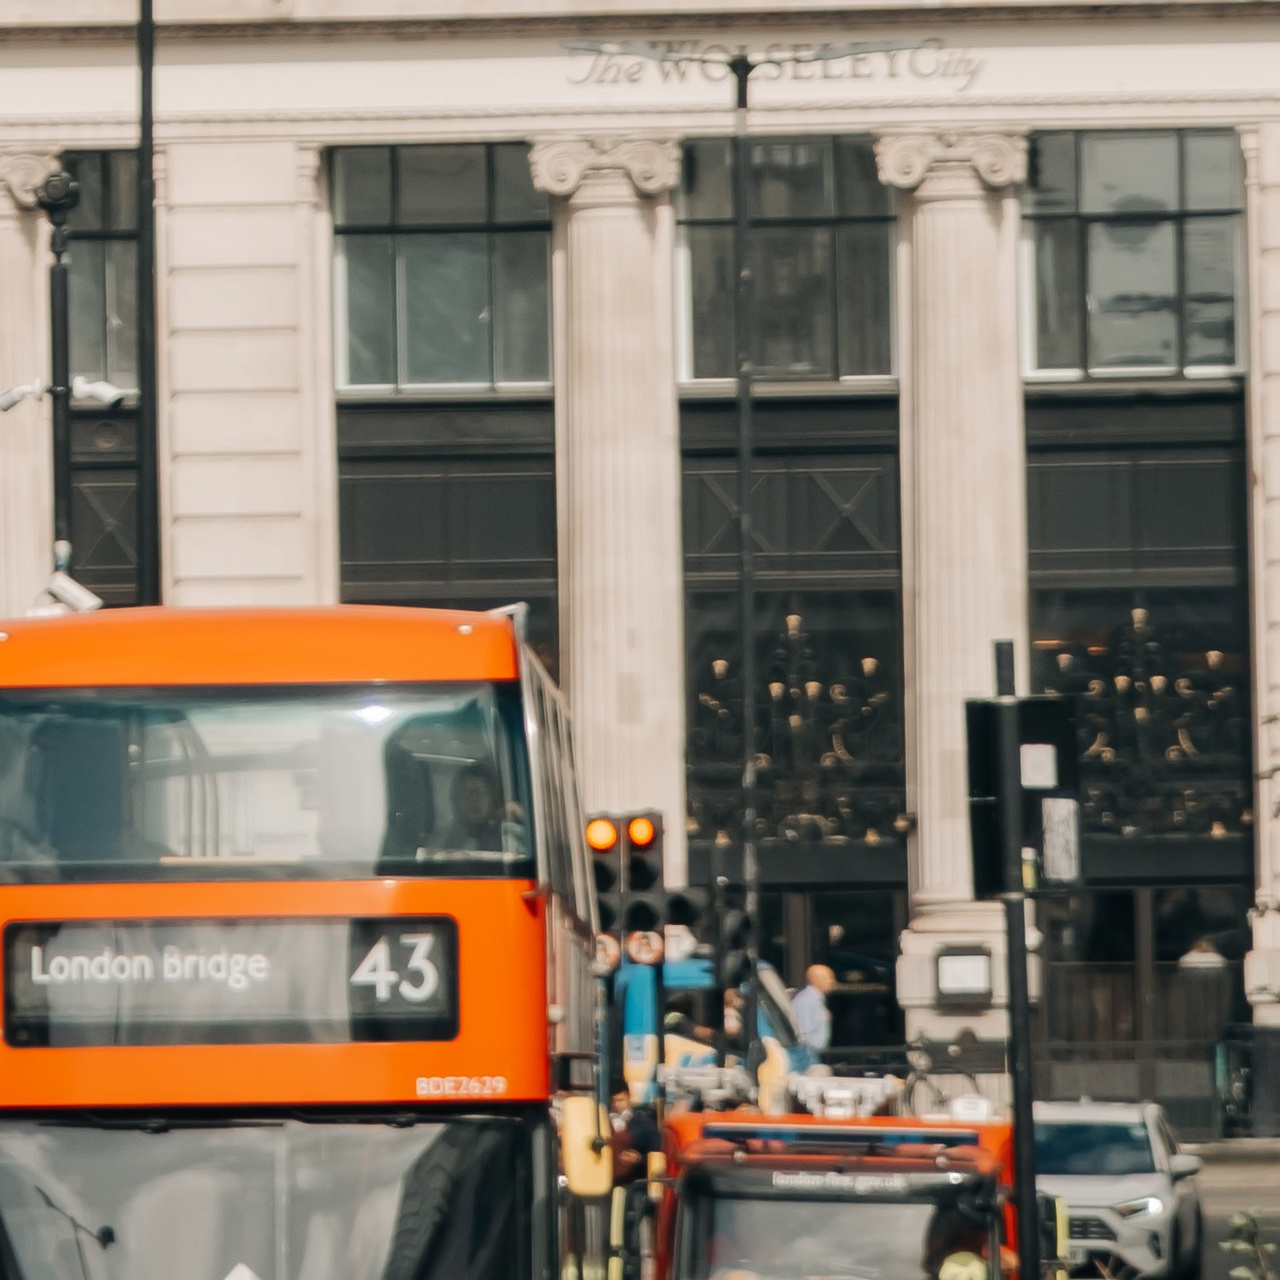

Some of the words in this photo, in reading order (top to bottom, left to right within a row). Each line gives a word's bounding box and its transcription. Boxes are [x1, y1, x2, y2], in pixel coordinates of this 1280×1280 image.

[565, 40, 644, 84] The
[906, 37, 986, 92] City
[31, 945, 153, 982] London
[162, 945, 271, 989] Bridge
[349, 932, 439, 1003] 43
[416, 1075, 508, 1097] BDE2629
